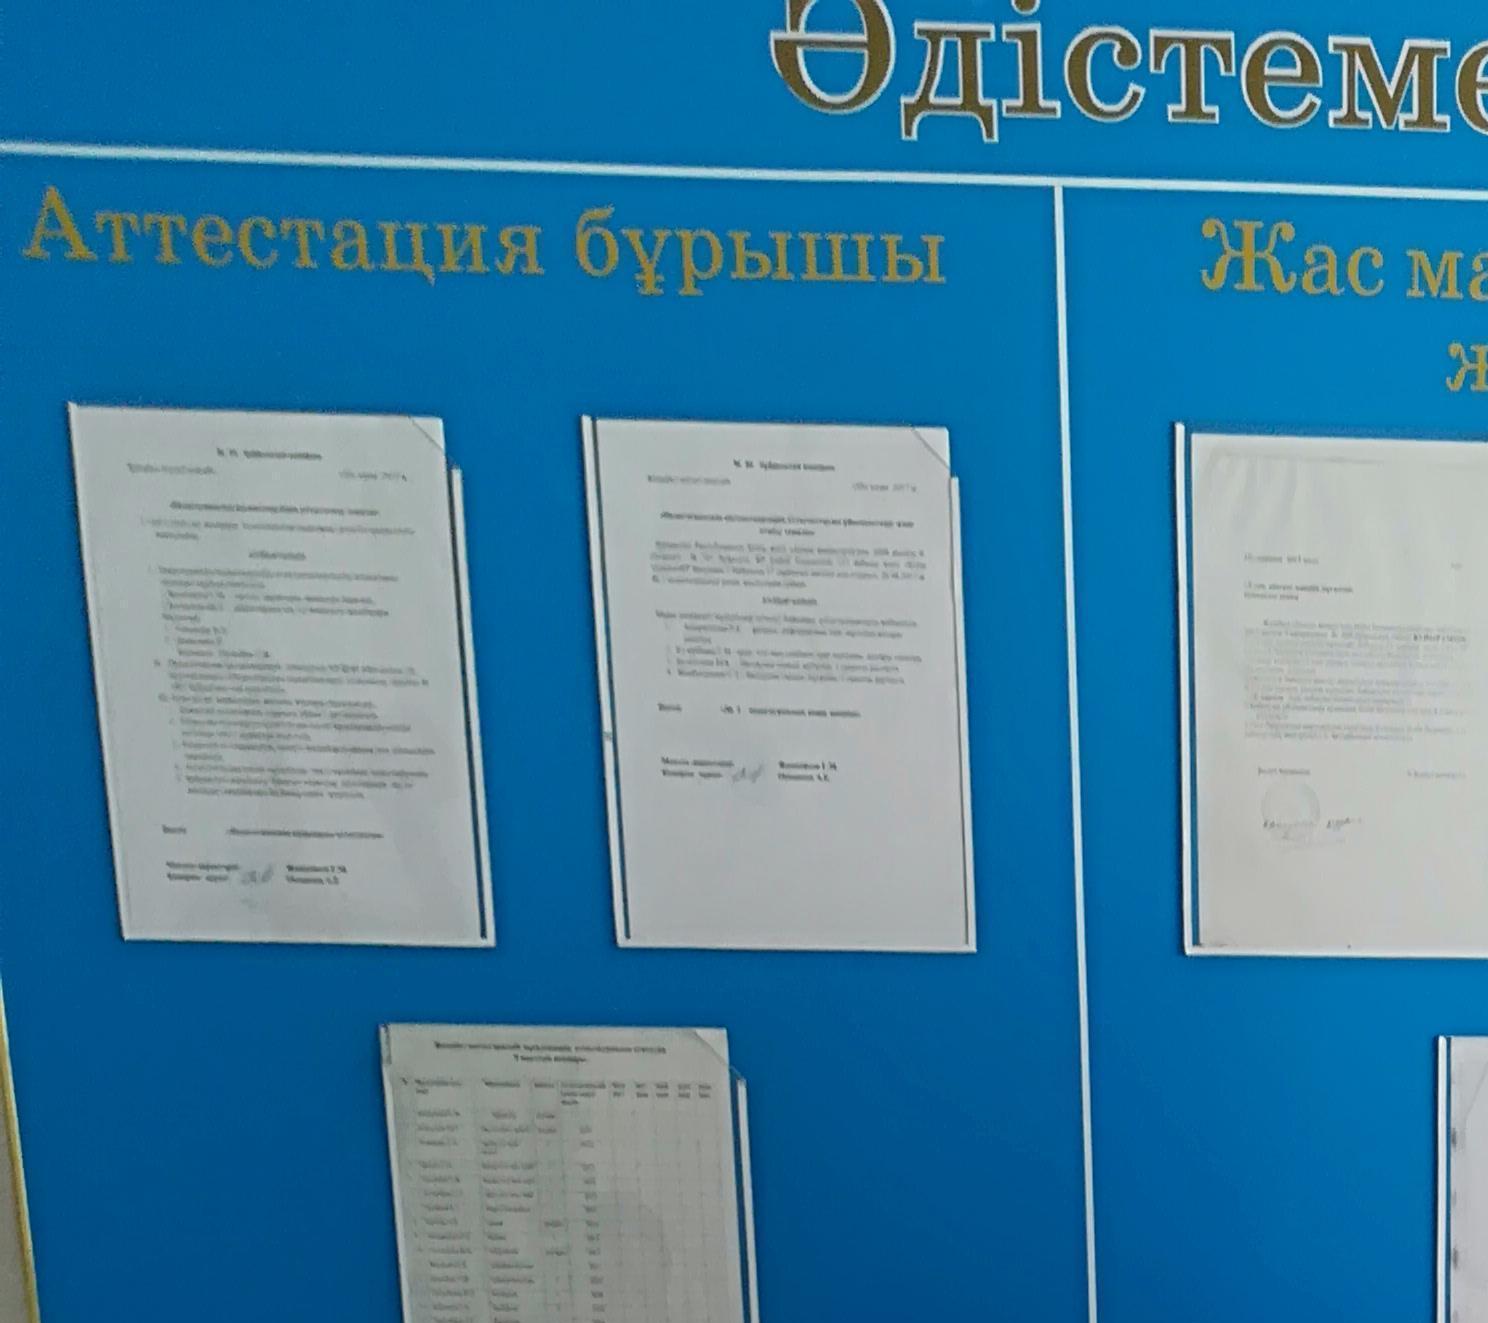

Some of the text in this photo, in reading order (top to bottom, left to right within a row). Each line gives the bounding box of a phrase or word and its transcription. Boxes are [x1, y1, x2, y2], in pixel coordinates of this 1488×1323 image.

[24, 186, 946, 295] Аттестация бұрышы
[1202, 219, 1385, 298] Жас
